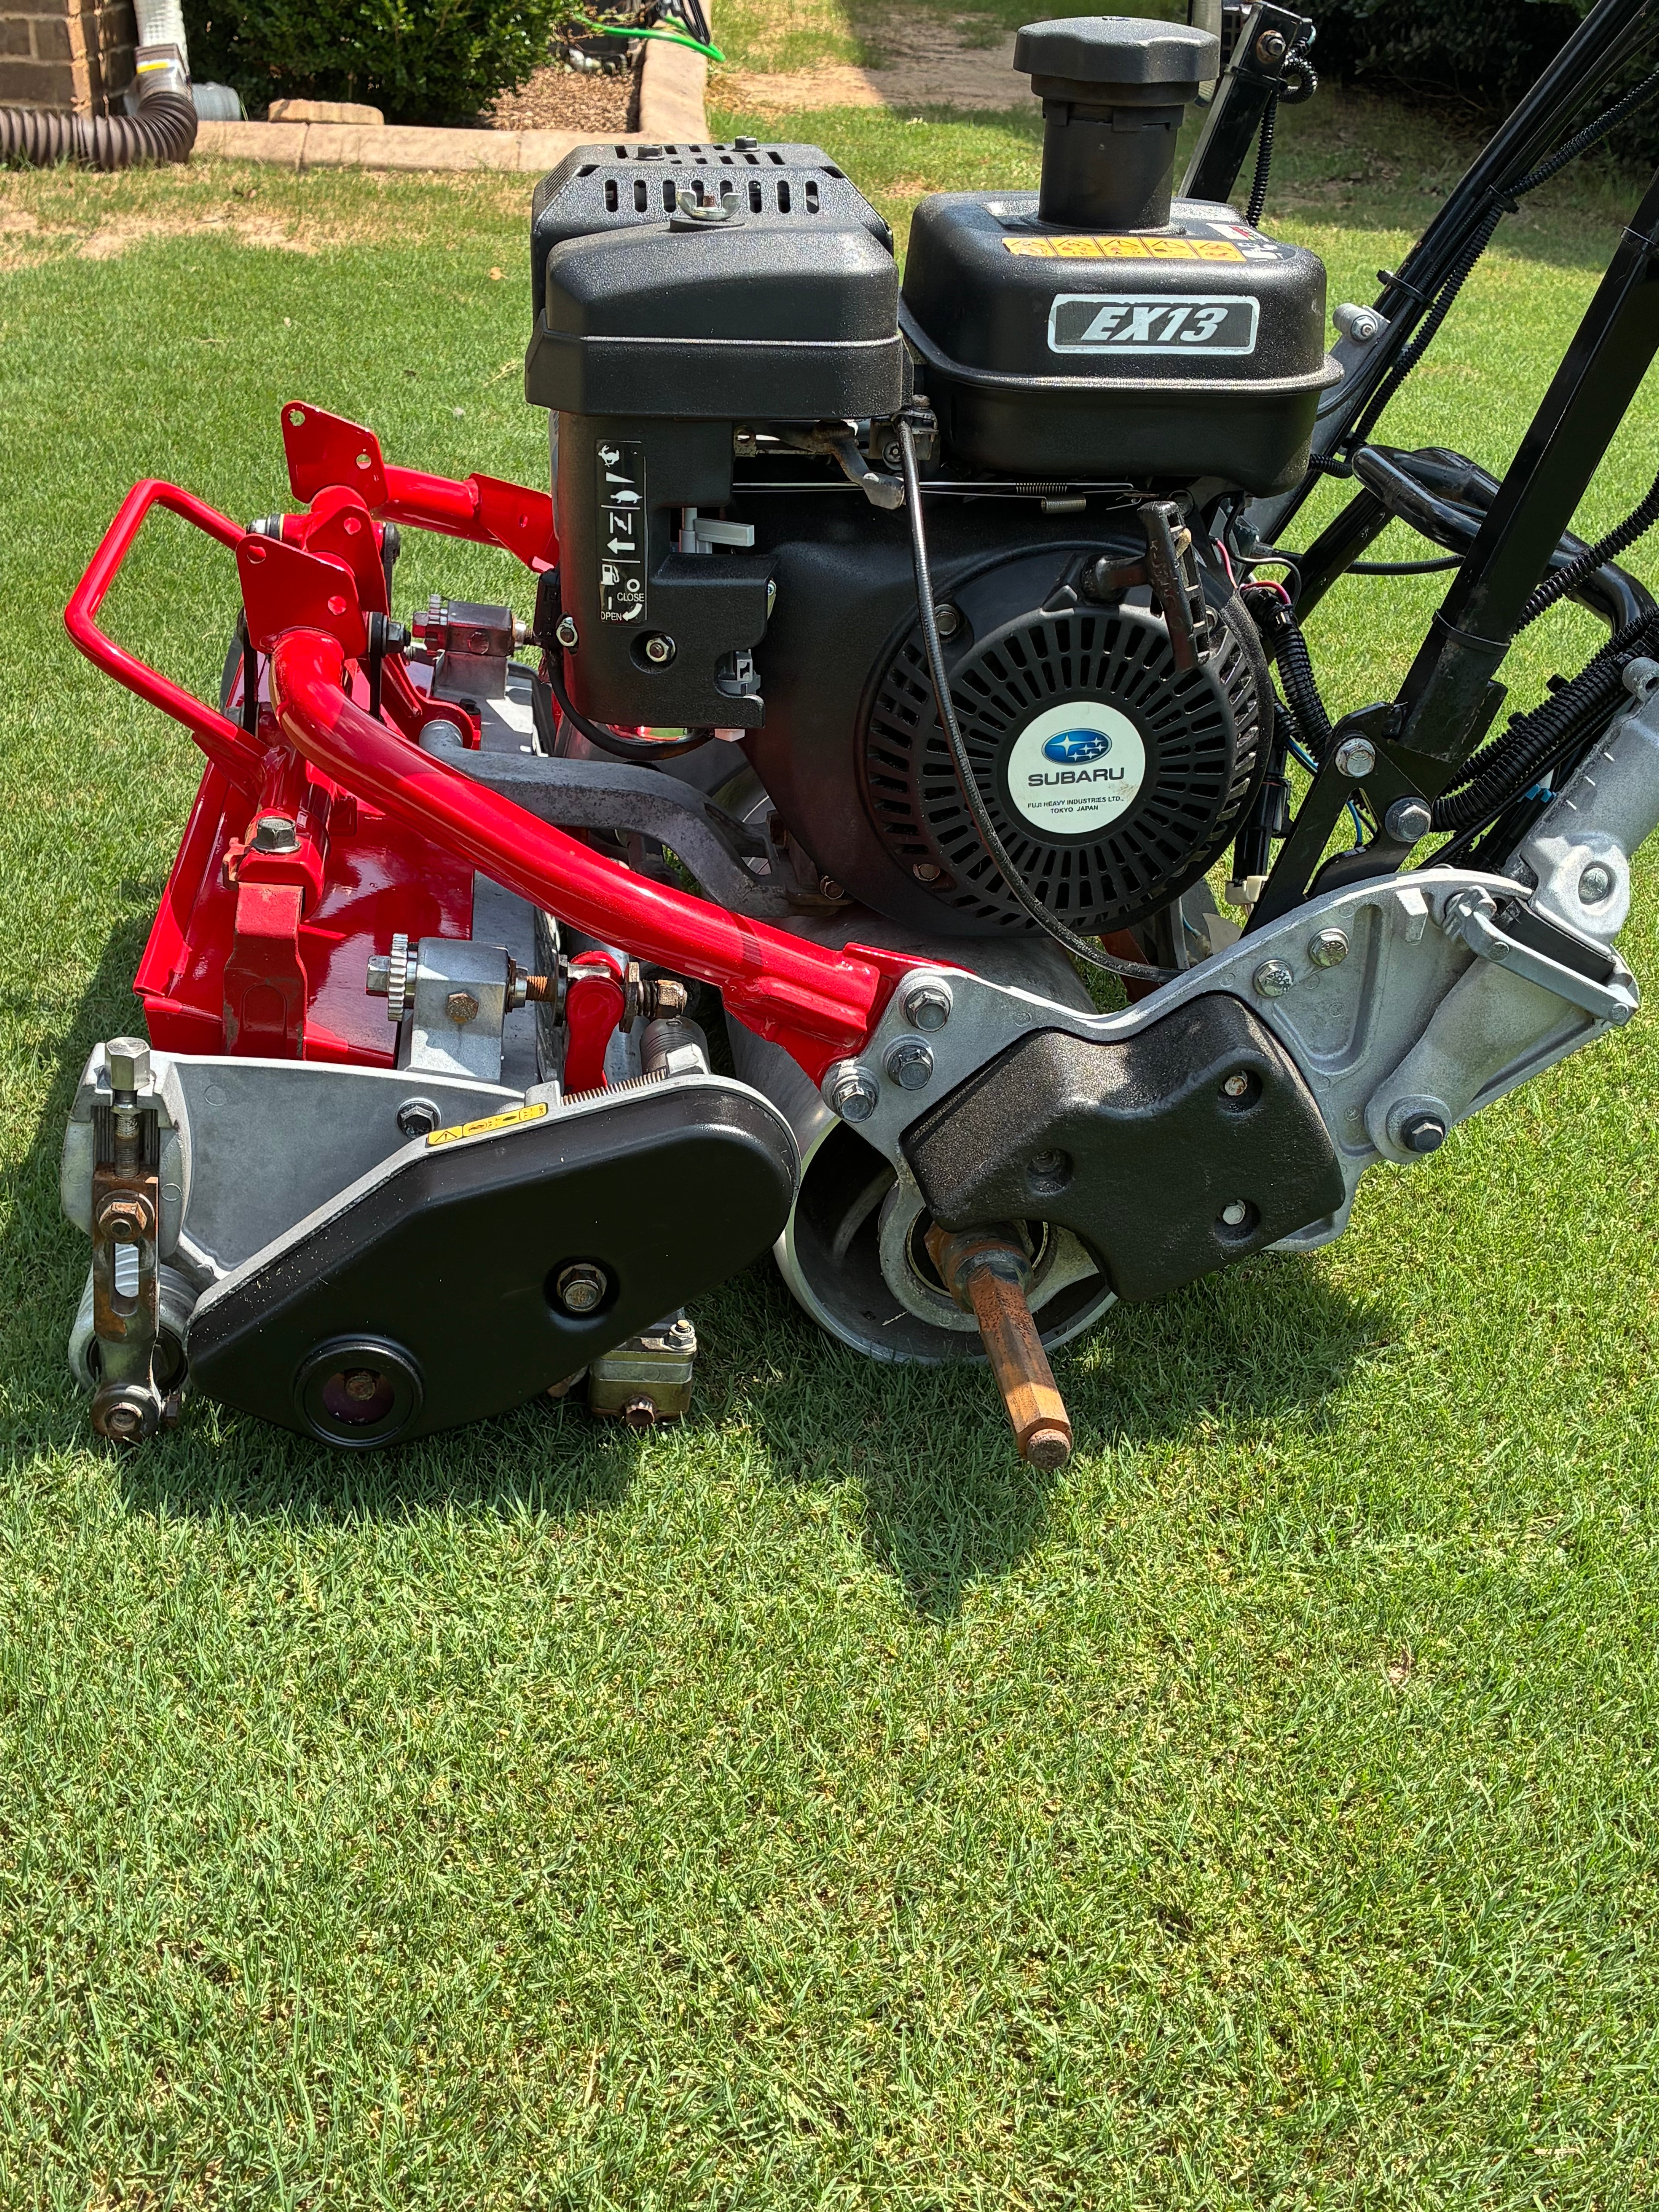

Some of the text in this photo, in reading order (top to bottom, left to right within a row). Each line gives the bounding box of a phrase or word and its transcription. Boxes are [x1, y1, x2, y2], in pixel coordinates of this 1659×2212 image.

[1081, 307, 1228, 342] EX13
[617, 592, 645, 602] CLOSE
[601, 611, 622, 621] OPEN
[1028, 767, 1124, 786] SUBARU
[1067, 797, 1106, 805] INDUSTRIES
